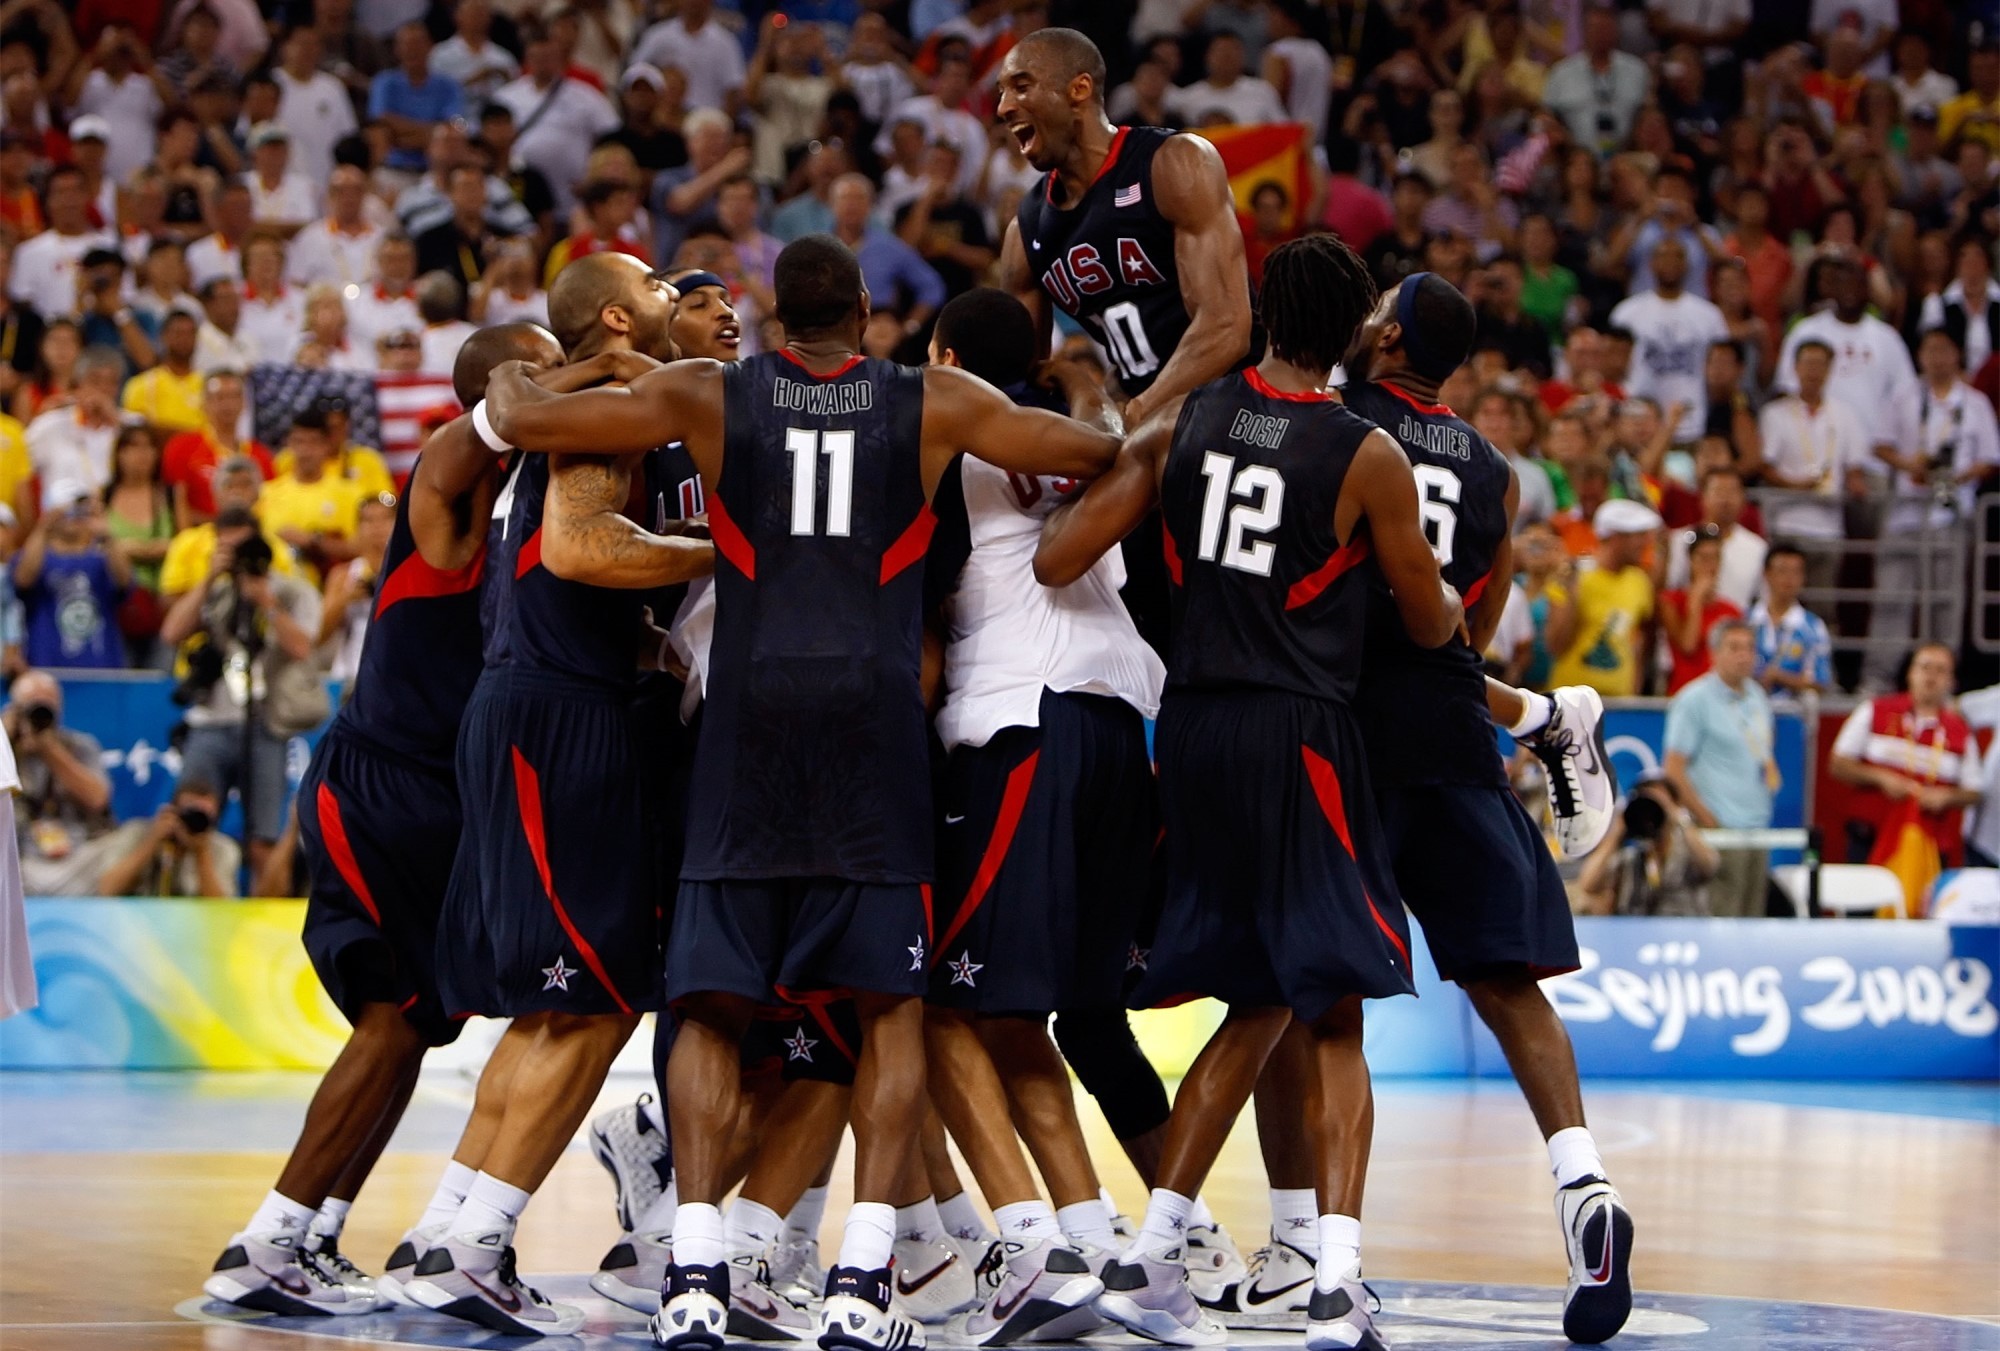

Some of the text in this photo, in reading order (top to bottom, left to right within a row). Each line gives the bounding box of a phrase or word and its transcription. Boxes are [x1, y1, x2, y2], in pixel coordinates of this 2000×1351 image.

[1042, 238, 1166, 316] USA
[773, 376, 872, 415] HOWARD
[1229, 408, 1290, 449] BOSH
[1398, 415, 1471, 461] JAMES
[785, 427, 855, 537] 11
[1198, 450, 1285, 577] 12
[1412, 463, 1462, 567] 6
[1537, 941, 1998, 1056] Beijing 2008
[685, 1273, 708, 1281] USA
[877, 1282, 889, 1303] 11
